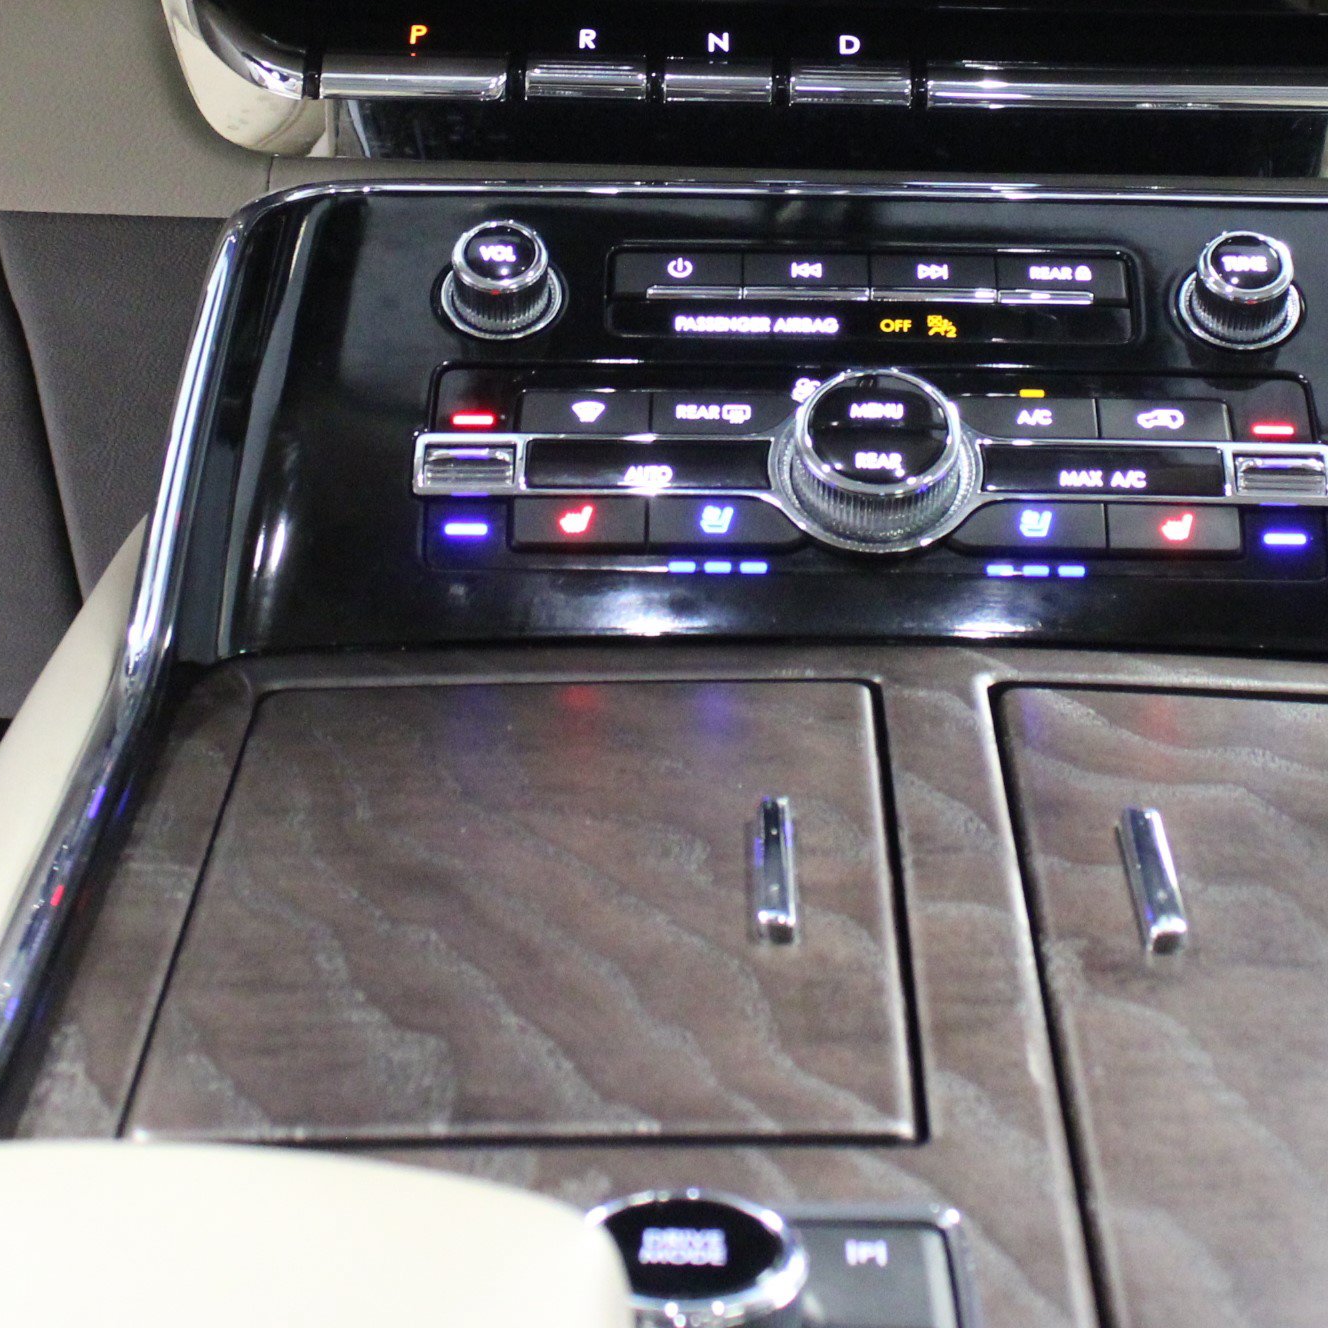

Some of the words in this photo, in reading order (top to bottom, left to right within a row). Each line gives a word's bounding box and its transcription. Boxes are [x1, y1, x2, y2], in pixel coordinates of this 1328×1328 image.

[409, 25, 428, 44] P
[579, 29, 596, 49] R
[708, 32, 729, 53] N
[839, 35, 860, 55] D
[480, 246, 516, 262] VOL
[1029, 266, 1072, 281] REAR
[675, 316, 770, 333] PASSENGER
[773, 317, 839, 334] AIRBAG
[880, 318, 912, 333] OFF
[676, 405, 720, 420] REAR
[849, 403, 904, 419] MENU
[1017, 410, 1053, 427] A/C
[854, 452, 903, 470] REAR
[624, 465, 674, 484] AUTO
[1059, 471, 1103, 488] MAX
[1110, 472, 1147, 489] A/C
